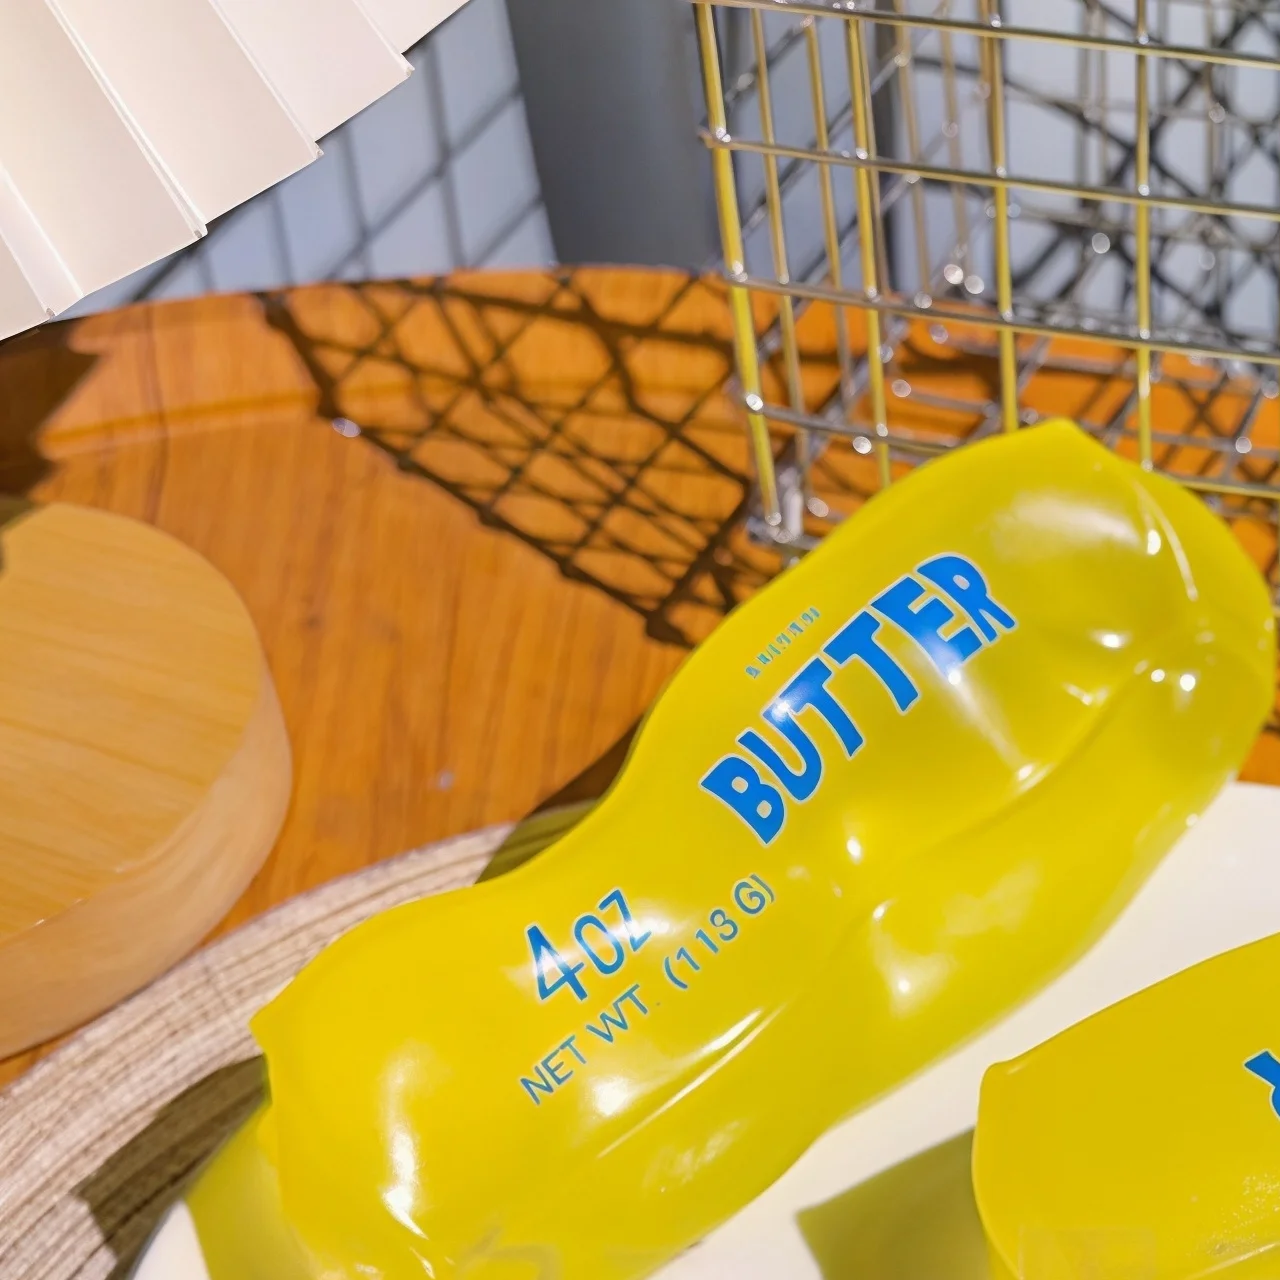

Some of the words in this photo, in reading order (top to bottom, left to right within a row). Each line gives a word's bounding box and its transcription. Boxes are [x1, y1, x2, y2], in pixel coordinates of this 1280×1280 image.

[701, 554, 1016, 845] BUTTER
[519, 1034, 587, 1106] NET
[733, 873, 775, 915] G)
